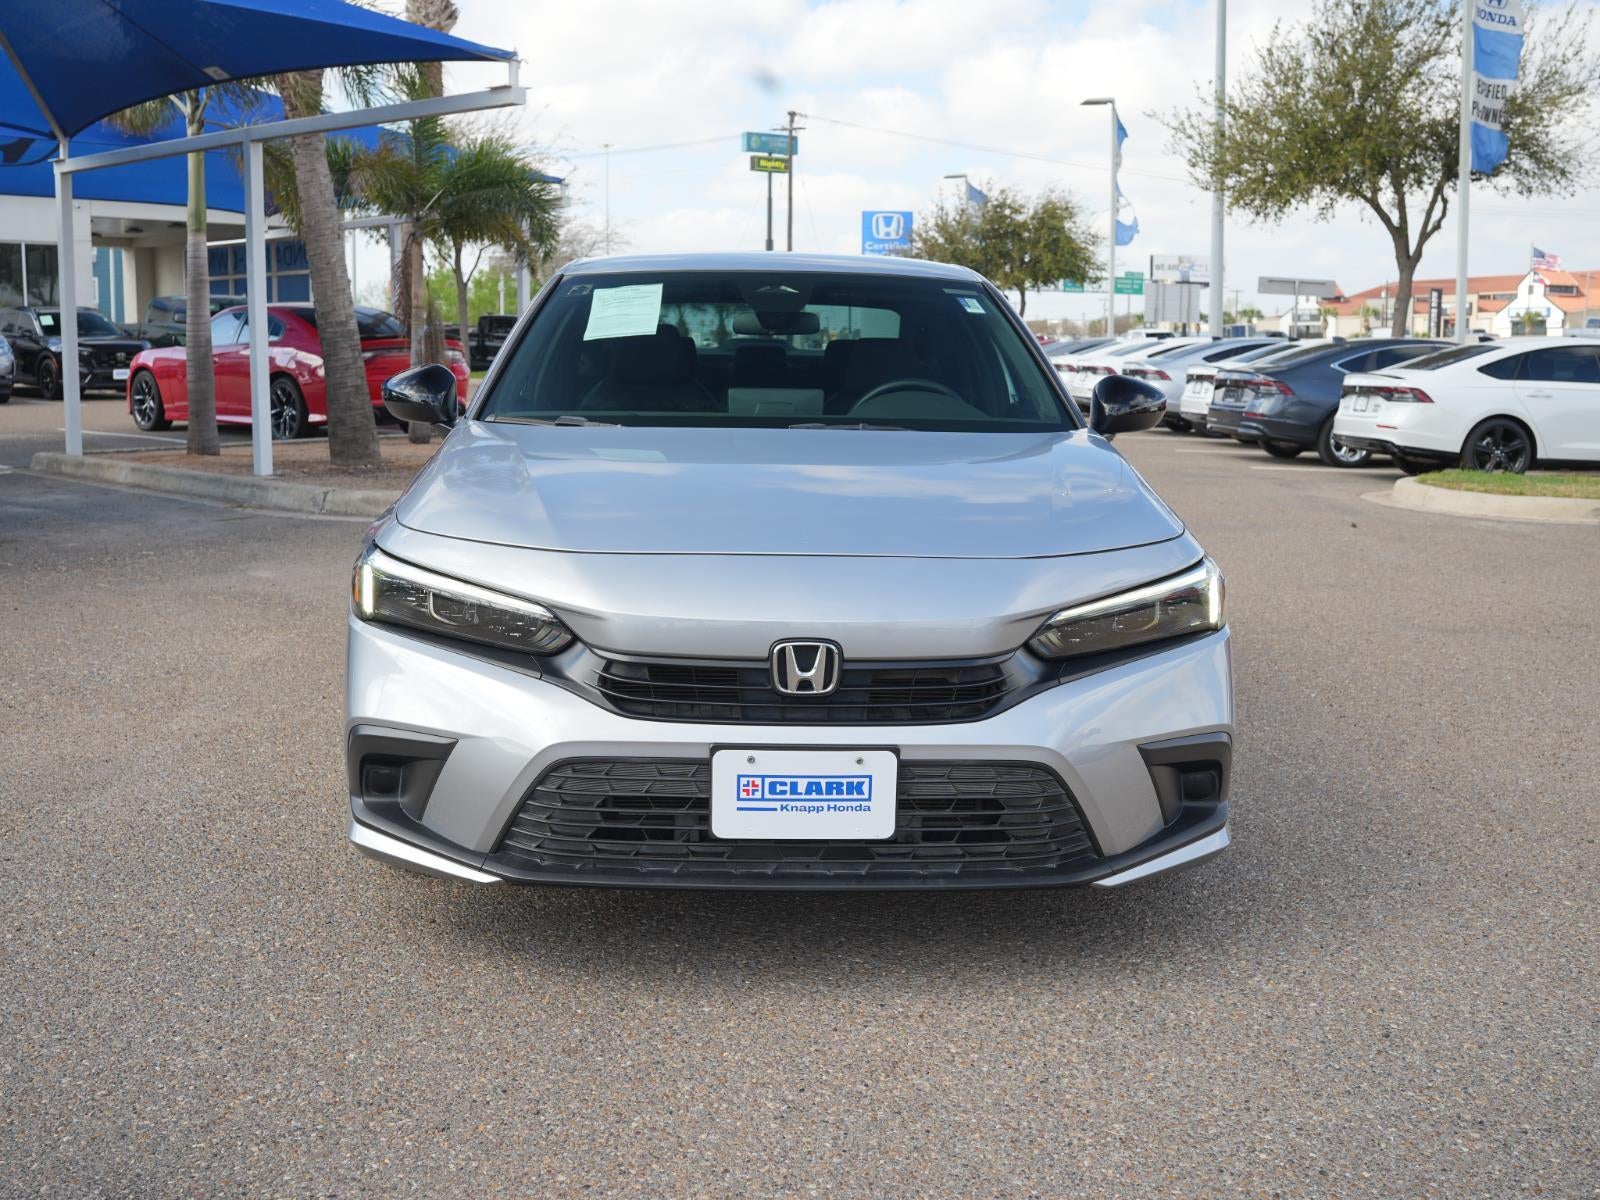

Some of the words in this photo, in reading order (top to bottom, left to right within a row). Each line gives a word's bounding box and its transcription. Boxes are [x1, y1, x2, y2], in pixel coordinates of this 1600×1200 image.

[768, 781, 865, 796] CLARK
[780, 804, 824, 814] Knapp
[827, 804, 871, 812] Honda
